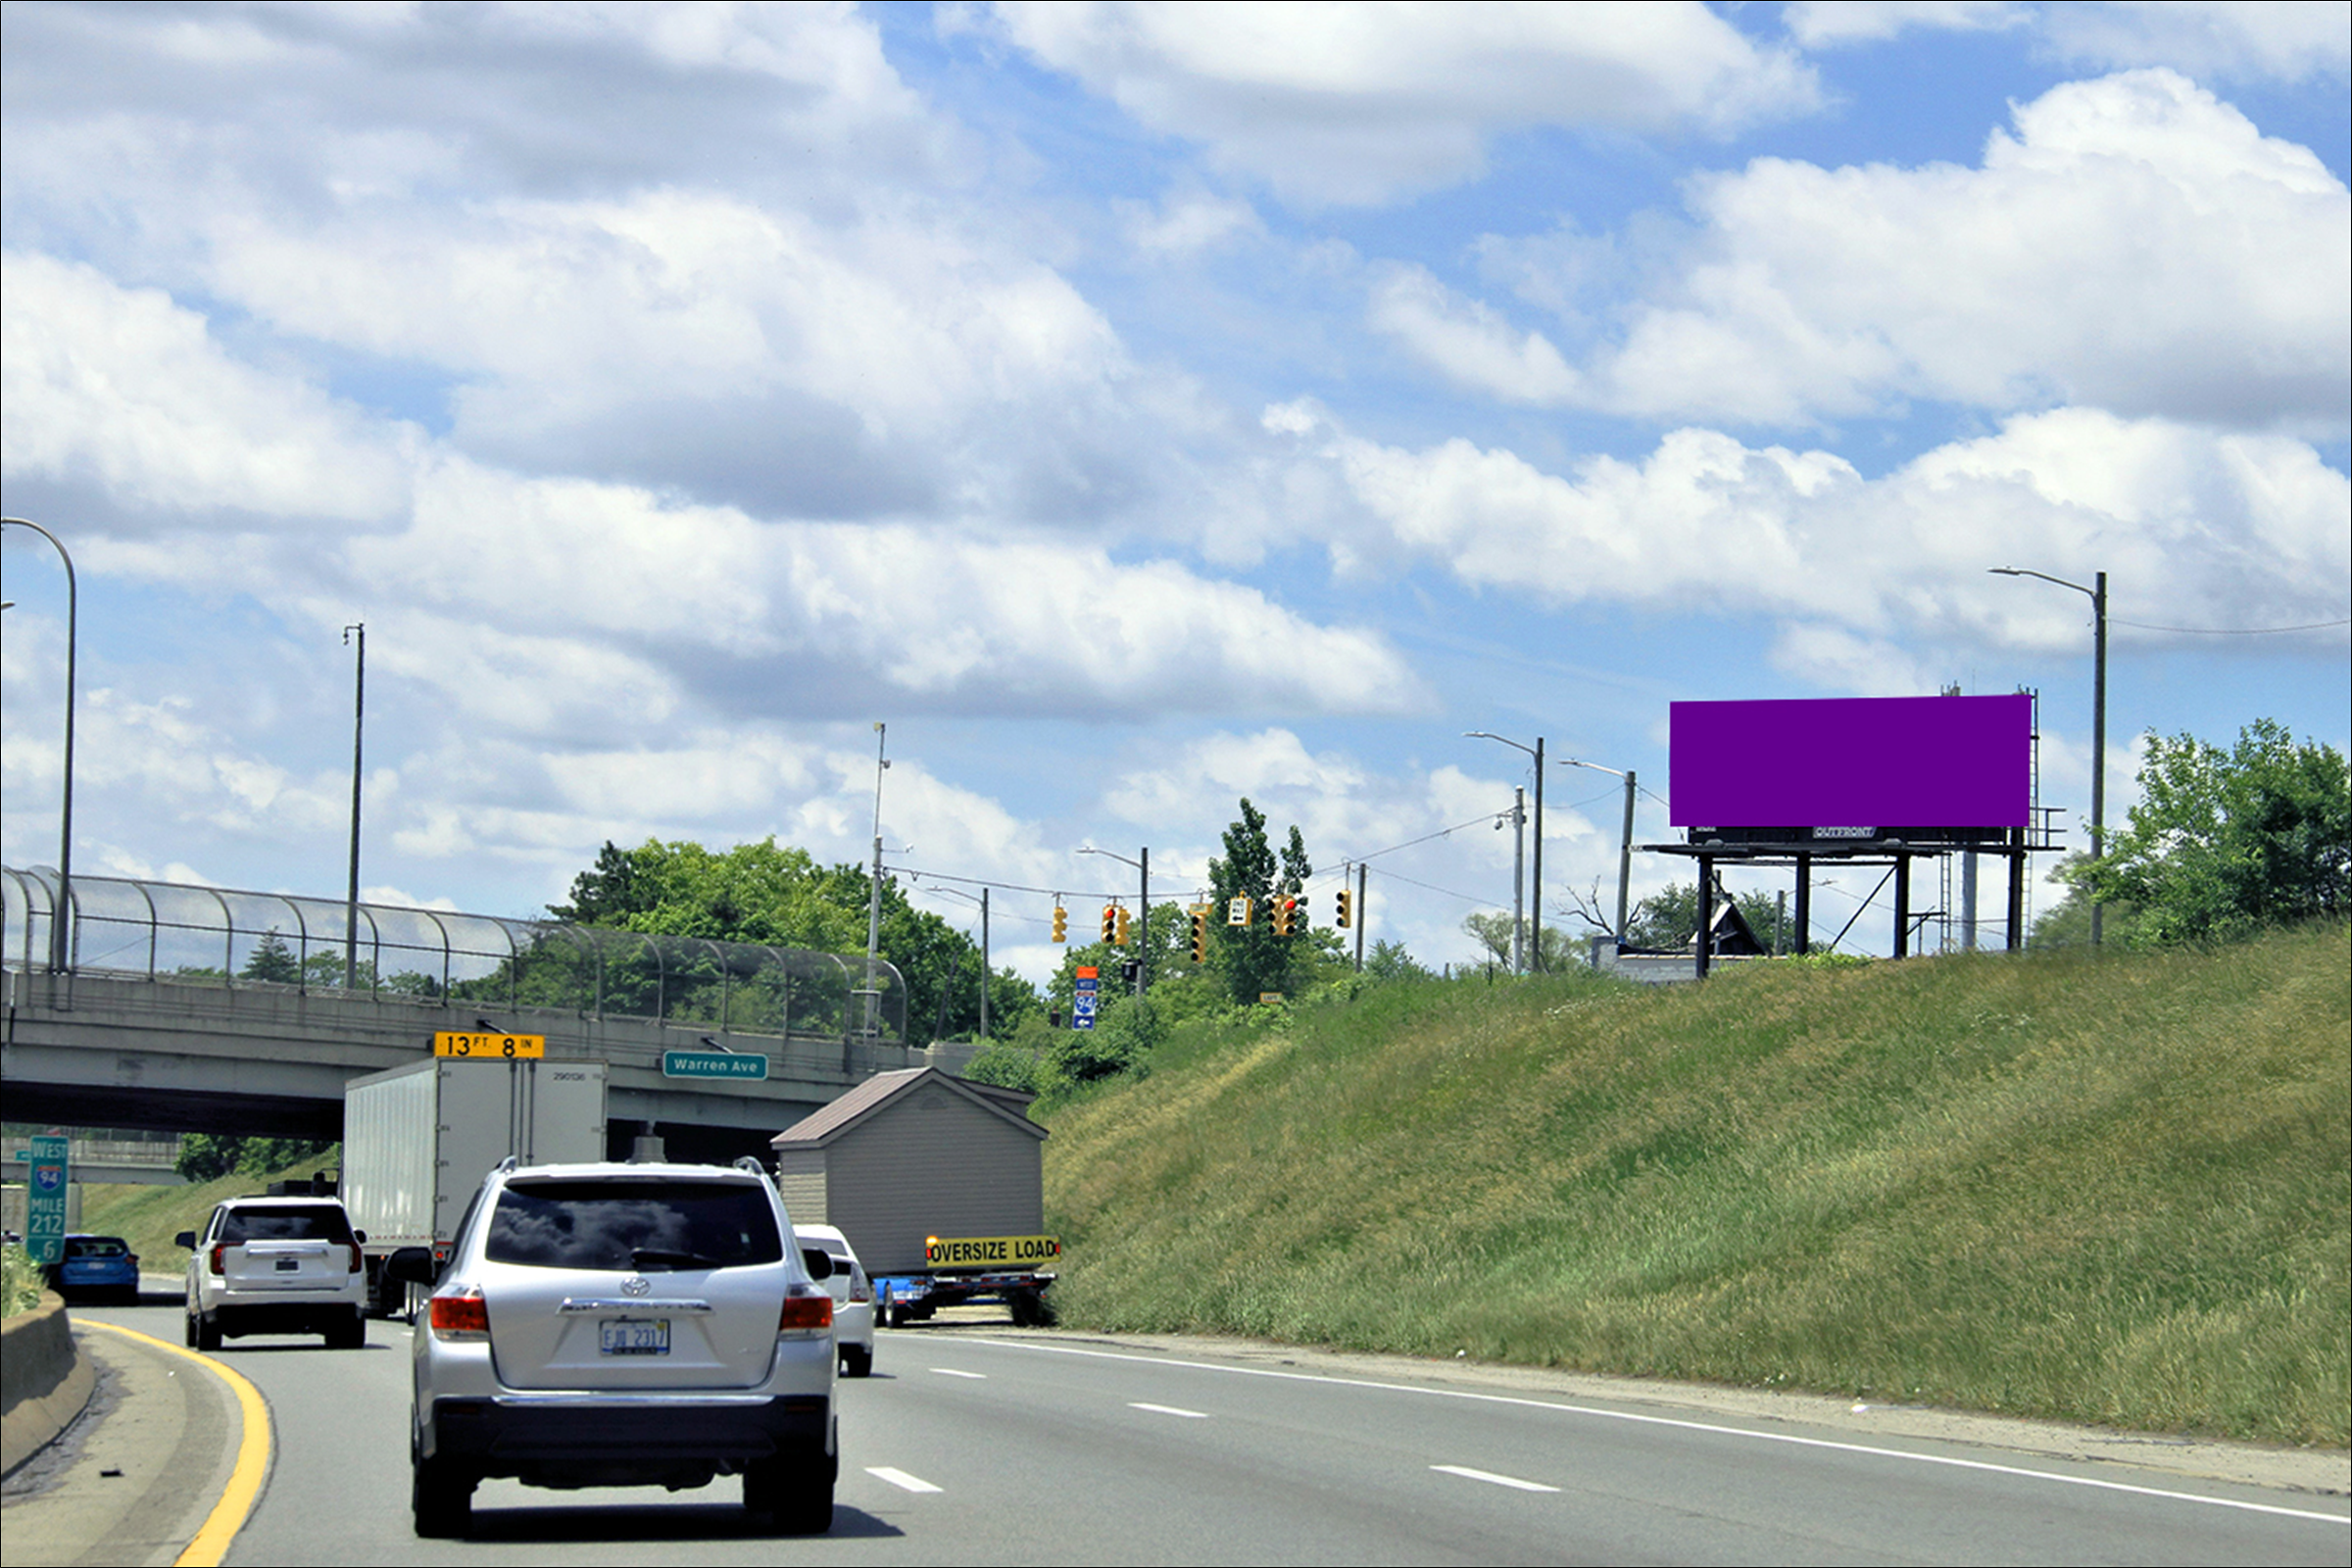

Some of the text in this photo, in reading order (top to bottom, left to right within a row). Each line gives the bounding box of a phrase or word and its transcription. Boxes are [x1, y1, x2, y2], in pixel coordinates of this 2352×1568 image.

[1814, 826, 1873, 837] OUTFRONT
[1077, 997, 1093, 1009] 94
[447, 1036, 470, 1055] 13
[503, 1038, 515, 1057] 8
[520, 1039, 533, 1049] IN
[674, 1058, 758, 1073] Warren Ave
[32, 1142, 68, 1158] WEST
[39, 1171, 58, 1184] 94
[30, 1198, 64, 1213] MILE
[30, 1215, 62, 1234] 212
[931, 1240, 1056, 1262] OVERSIZE LOAD
[634, 1329, 665, 1347] 2317
